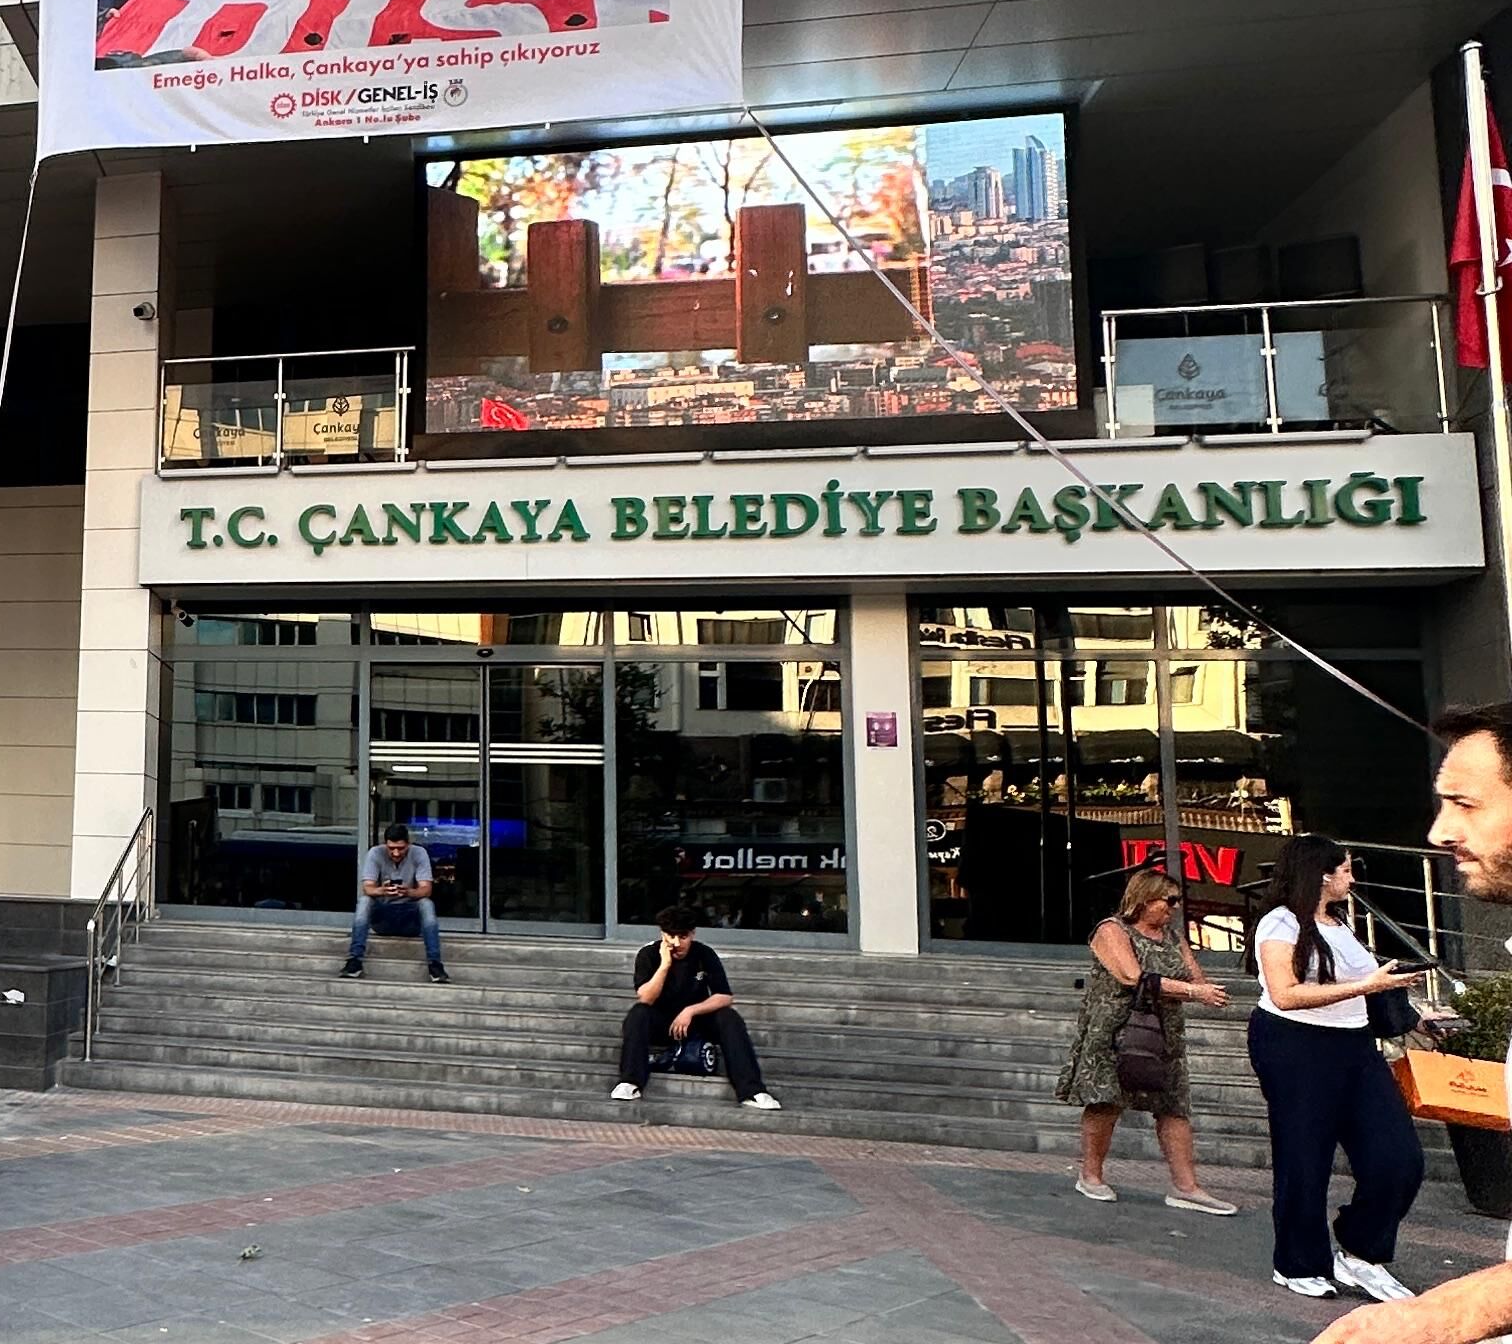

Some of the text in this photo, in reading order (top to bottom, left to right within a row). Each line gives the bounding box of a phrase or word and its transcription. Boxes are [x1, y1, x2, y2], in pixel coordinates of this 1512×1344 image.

[152, 70, 223, 90] Emeğe,
[230, 60, 296, 82] Halka,
[436, 49, 494, 69] sahip
[499, 40, 601, 68] çıkıyoruz
[314, 117, 353, 127] Ankara
[313, 422, 360, 435] Çankay
[182, 471, 1428, 555] T.C. ÇANKAYA BELEDİYE BAŞKANLIĞI
